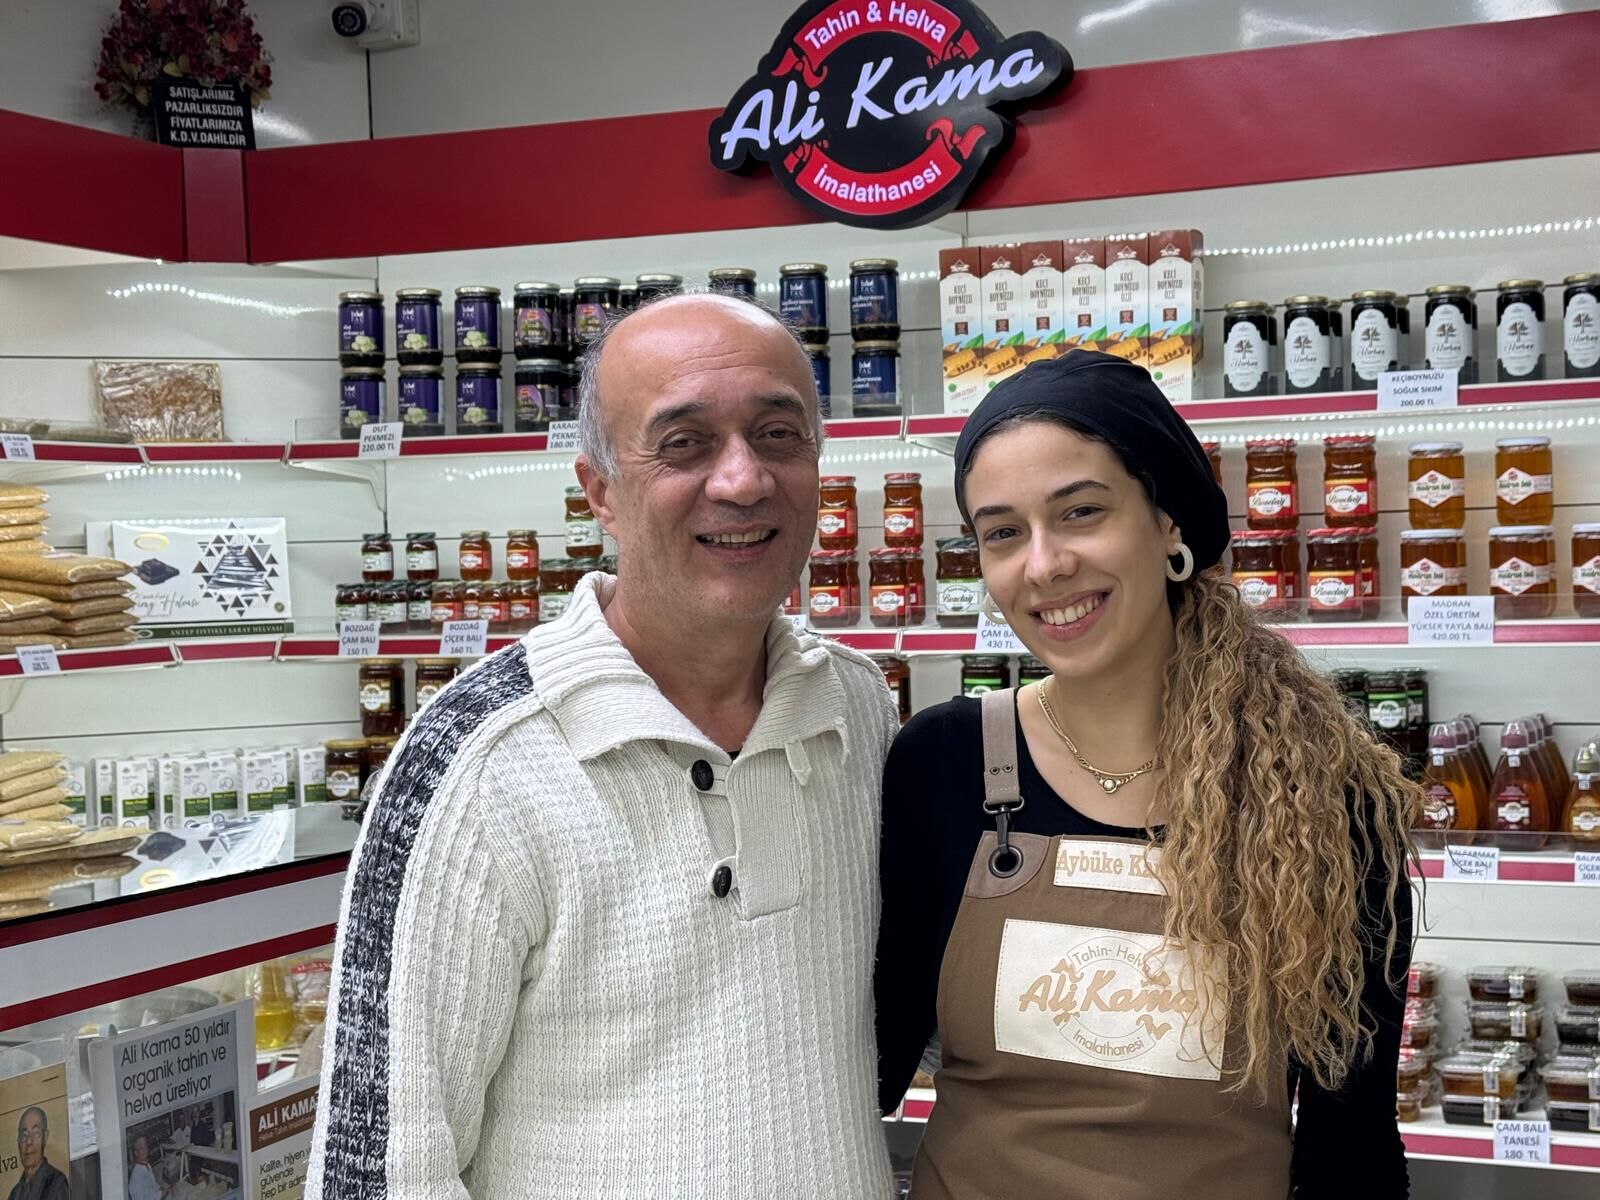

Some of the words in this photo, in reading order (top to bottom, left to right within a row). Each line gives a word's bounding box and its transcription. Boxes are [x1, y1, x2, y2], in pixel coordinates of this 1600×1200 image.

[804, 6, 861, 50] Tahin
[866, 0, 882, 23] &
[889, 1, 947, 43] Helva
[170, 87, 235, 101] SATIŞLARIMIZ
[165, 101, 244, 117] PAZARLIKSIZDIR
[720, 80, 825, 160] Ali
[847, 48, 1045, 129] Kama
[170, 115, 243, 131] FİYATLARIMIZA
[170, 130, 246, 146] K.D.V.DAHİLDİR
[813, 159, 942, 204] İmalathanesi
[1393, 387, 1419, 395] SOĞUK
[372, 425, 388, 433] DUT
[1424, 610, 1444, 619] ÖZEL
[1446, 609, 1480, 619] ÜRETİM
[344, 623, 375, 633] BOZDAĞ
[449, 622, 479, 631] BOZDAĞ
[1411, 622, 1443, 630] YÜKSEK
[342, 637, 359, 645] ÇAM
[360, 636, 376, 644] BALI
[444, 633, 465, 643] ÇİÇEK
[466, 633, 482, 642] BALI
[982, 630, 1001, 639] ÇAM
[464, 646, 473, 654] TL
[1056, 850, 1123, 877] Aybüke
[1117, 944, 1152, 974] Helva
[1018, 974, 1080, 1013] Ali
[1080, 970, 1199, 1014] Kama
[121, 1044, 137, 1067] Ali
[141, 1035, 181, 1060] Kama
[184, 1026, 200, 1046] 50
[203, 1019, 230, 1044] yıldır
[123, 1059, 175, 1091] organik
[177, 1048, 208, 1074] tahin
[211, 1045, 226, 1062] ve
[125, 1091, 162, 1118] helva
[166, 1074, 211, 1103] üretiyor
[258, 1107, 279, 1132] ALİ
[1495, 1122, 1521, 1134] ÇAM
[1523, 1123, 1547, 1133] BALI
[1503, 1134, 1540, 1146] TANESİ
[1504, 1150, 1523, 1160] 180
[1529, 1150, 1540, 1160] TL
[260, 1167, 294, 1190] güvende
[278, 1182, 288, 1193] bir
